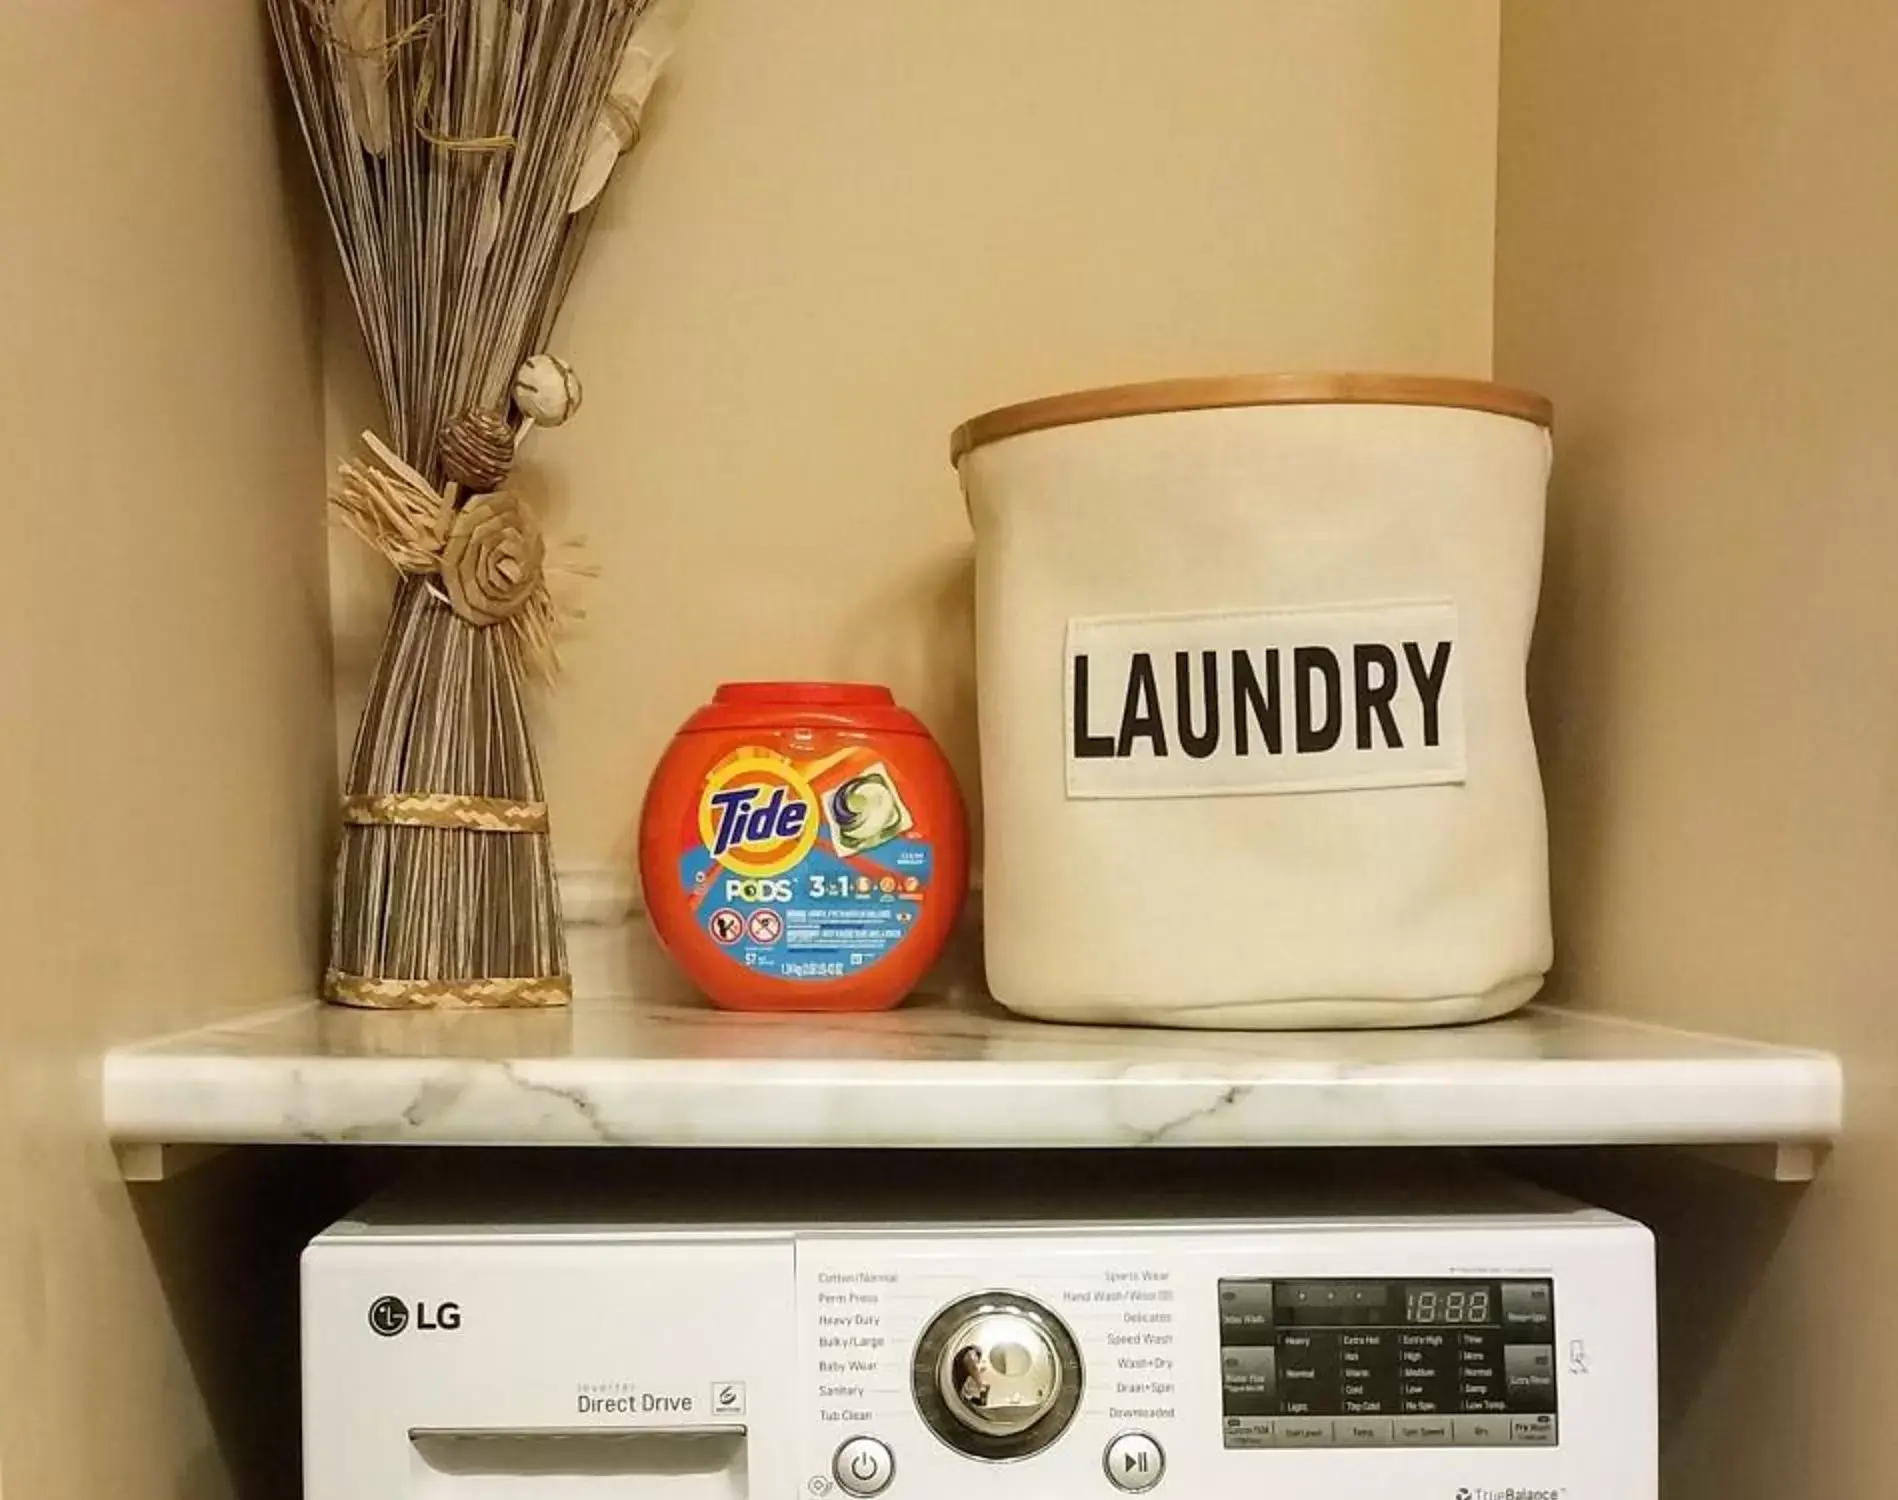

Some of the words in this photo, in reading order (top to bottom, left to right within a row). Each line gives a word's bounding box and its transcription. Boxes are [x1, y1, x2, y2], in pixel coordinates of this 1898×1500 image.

[1074, 641, 1452, 758] LAUNDRY
[711, 786, 808, 857] Tide
[726, 879, 793, 902] PODS
[1063, 1291, 1090, 1301] Hand
[417, 1302, 460, 1329] LG
[819, 1315, 851, 1326] Heavy
[855, 1314, 880, 1326] Duty
[1107, 1333, 1141, 1345] Speed
[819, 1361, 845, 1372] Baby
[819, 1385, 864, 1397] Sanitary
[577, 1395, 636, 1412] Direct
[642, 1393, 692, 1411] Drive
[842, 1410, 872, 1421] Clean
